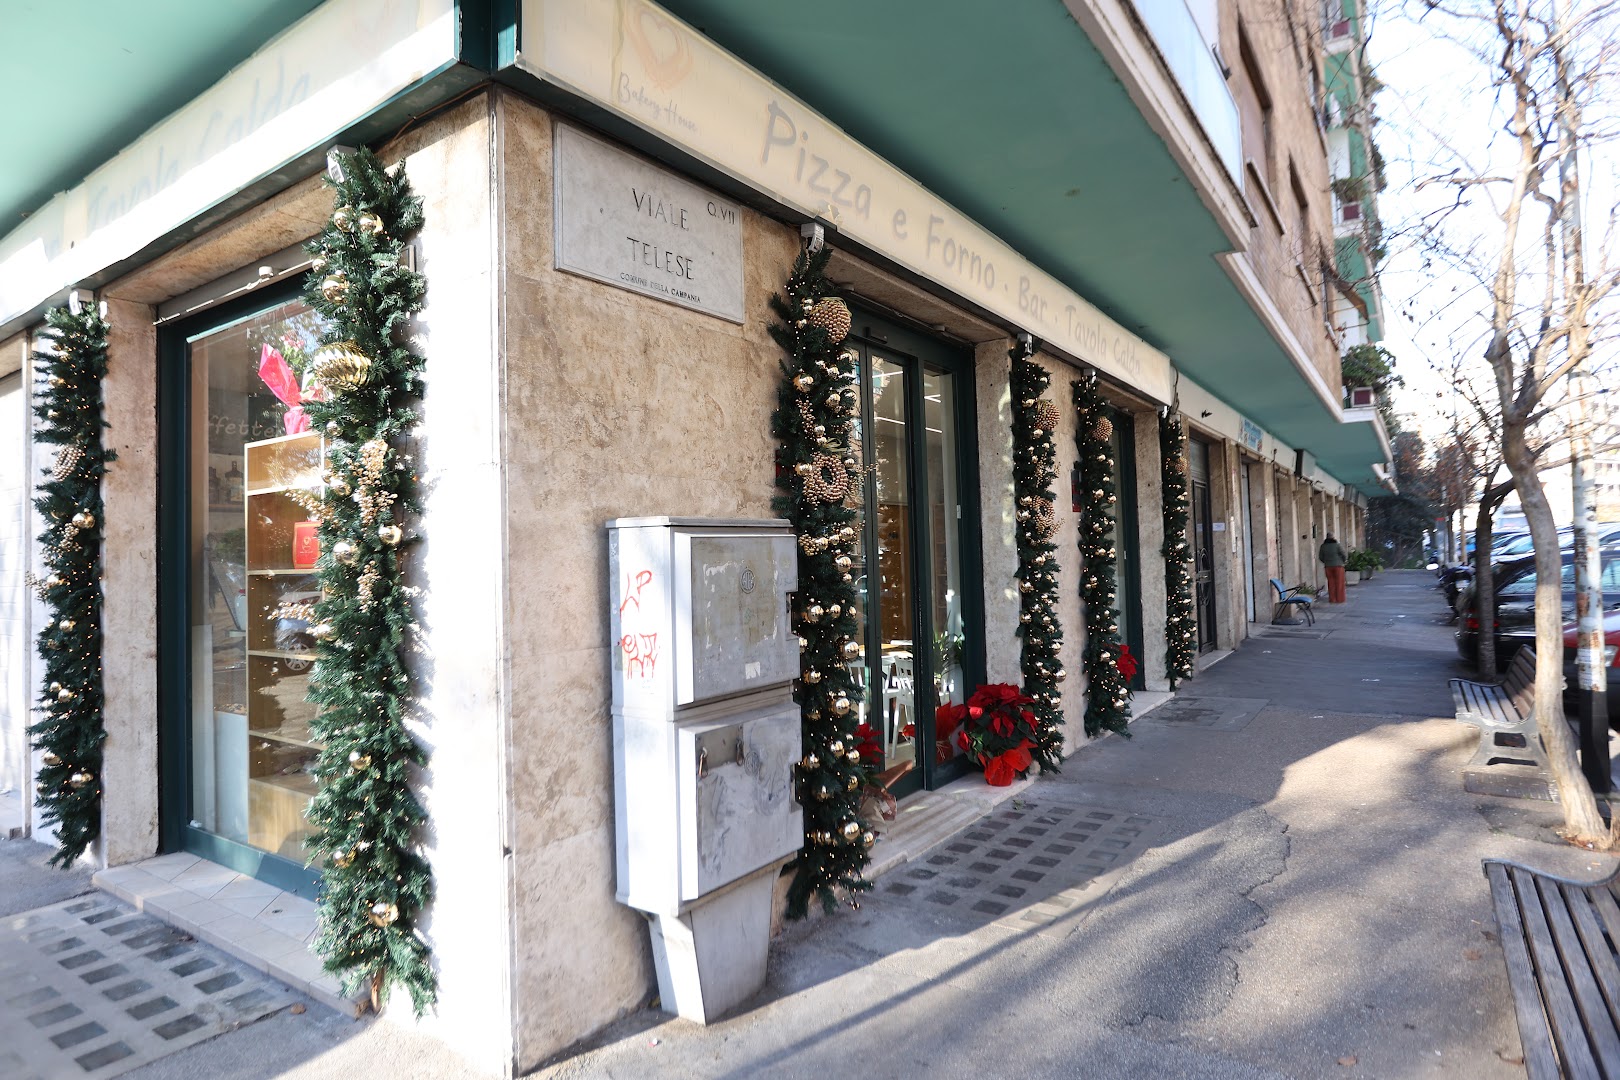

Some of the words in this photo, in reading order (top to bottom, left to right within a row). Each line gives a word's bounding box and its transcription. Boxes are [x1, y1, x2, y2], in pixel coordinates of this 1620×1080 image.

[617, 71, 661, 120] Bakery
[664, 98, 698, 132] House
[631, 187, 690, 232] VIALE
[707, 201, 735, 225] Q.VII
[626, 236, 695, 281] TELESE
[762, 100, 872, 220] Pizza
[892, 207, 909, 240] e
[925, 212, 996, 291] Forno
[1018, 275, 1048, 322] Bar
[1065, 304, 1107, 361] Tavola
[1113, 337, 1141, 376] Calda
[650, 281, 669, 294] DELLA
[671, 288, 702, 304] CAMPANIA
